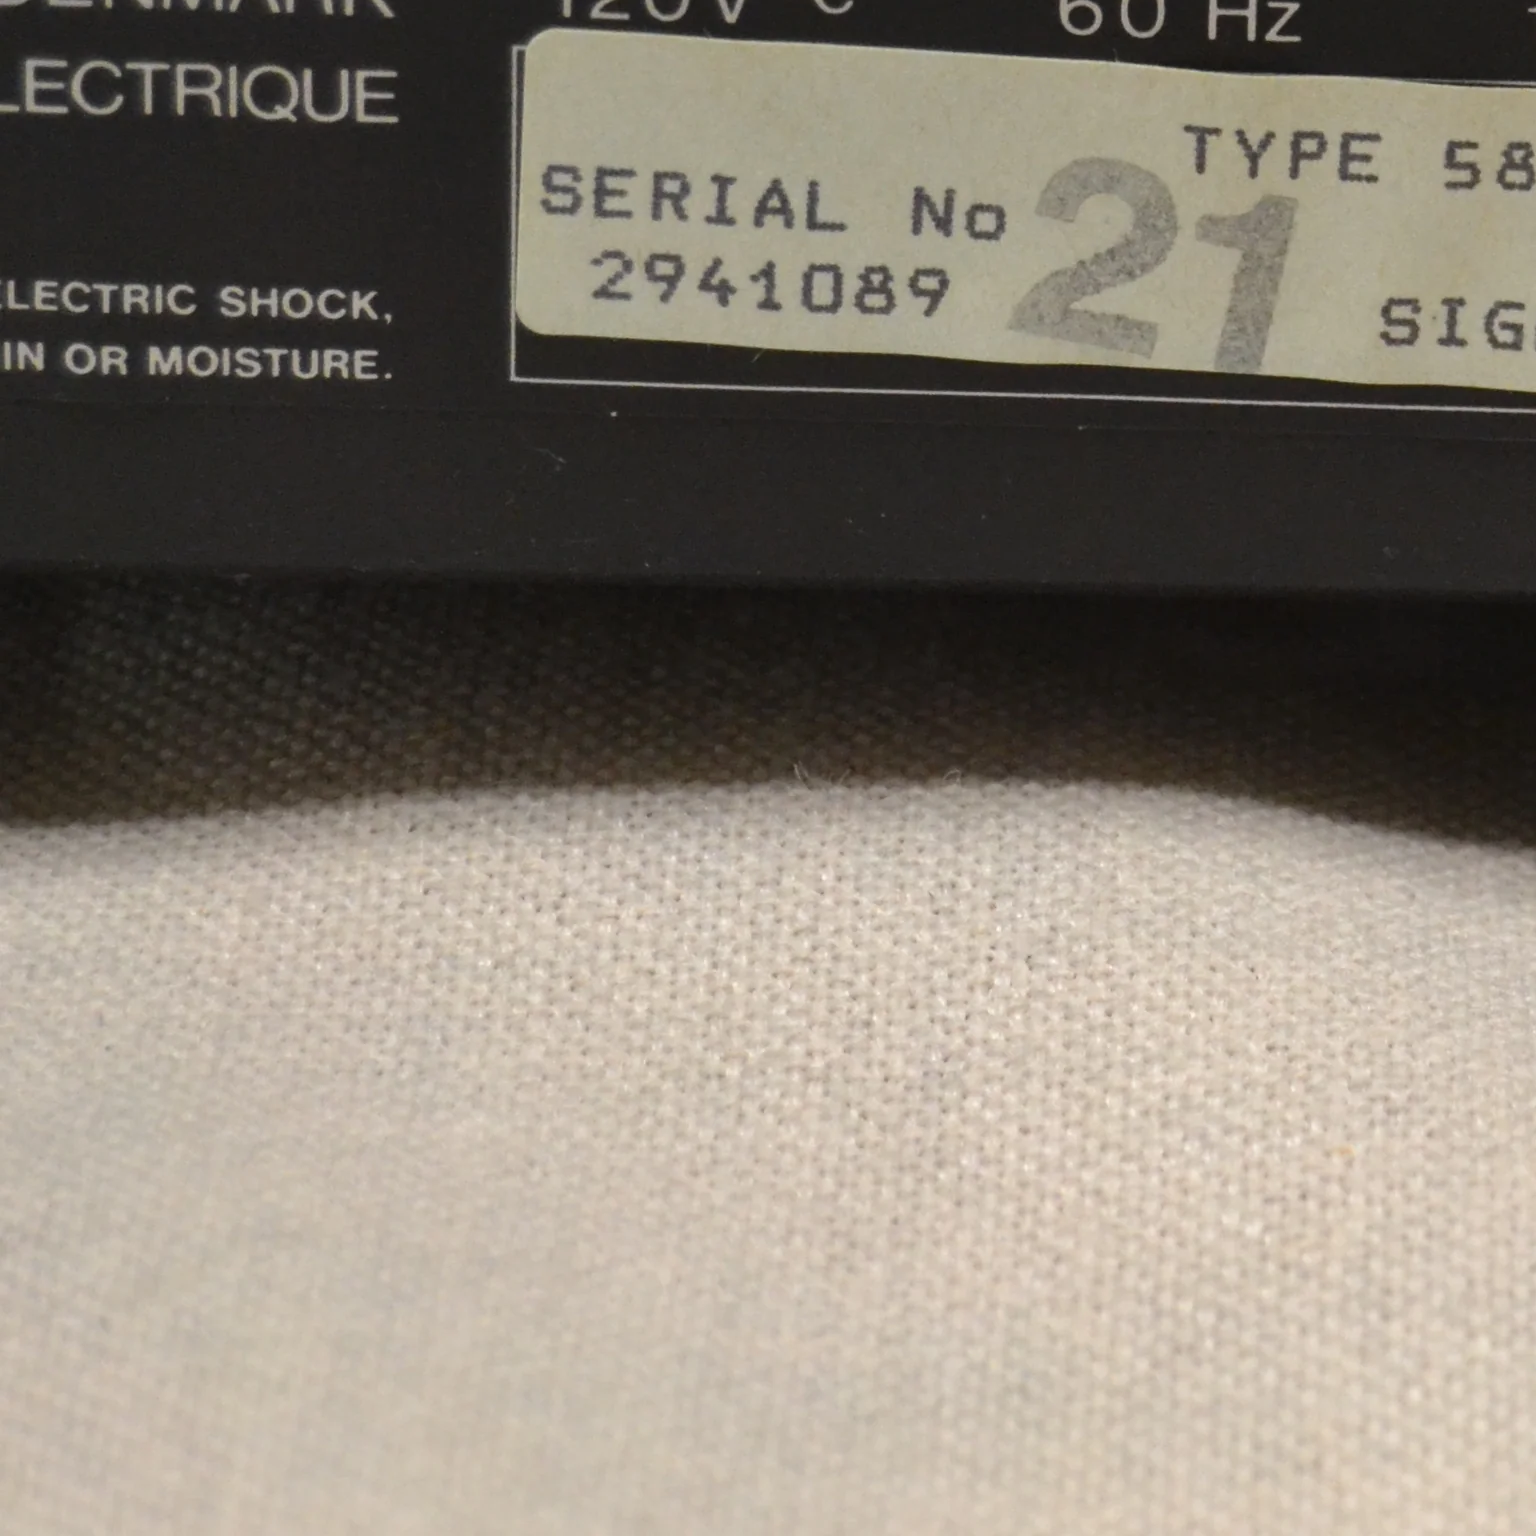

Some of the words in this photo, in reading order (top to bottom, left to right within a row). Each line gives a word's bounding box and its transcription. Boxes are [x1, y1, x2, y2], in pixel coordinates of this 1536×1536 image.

[1183, 124, 1383, 184] TYPE
[541, 164, 847, 232] SERIAL
[911, 185, 1007, 242] No
[590, 250, 950, 317] 2941089
[1007, 156, 1298, 374] 21
[0, 280, 198, 316] LECTRIC
[219, 286, 393, 325] SHOCK,
[64, 343, 128, 376] OR
[148, 346, 393, 380] MOISTURE.
